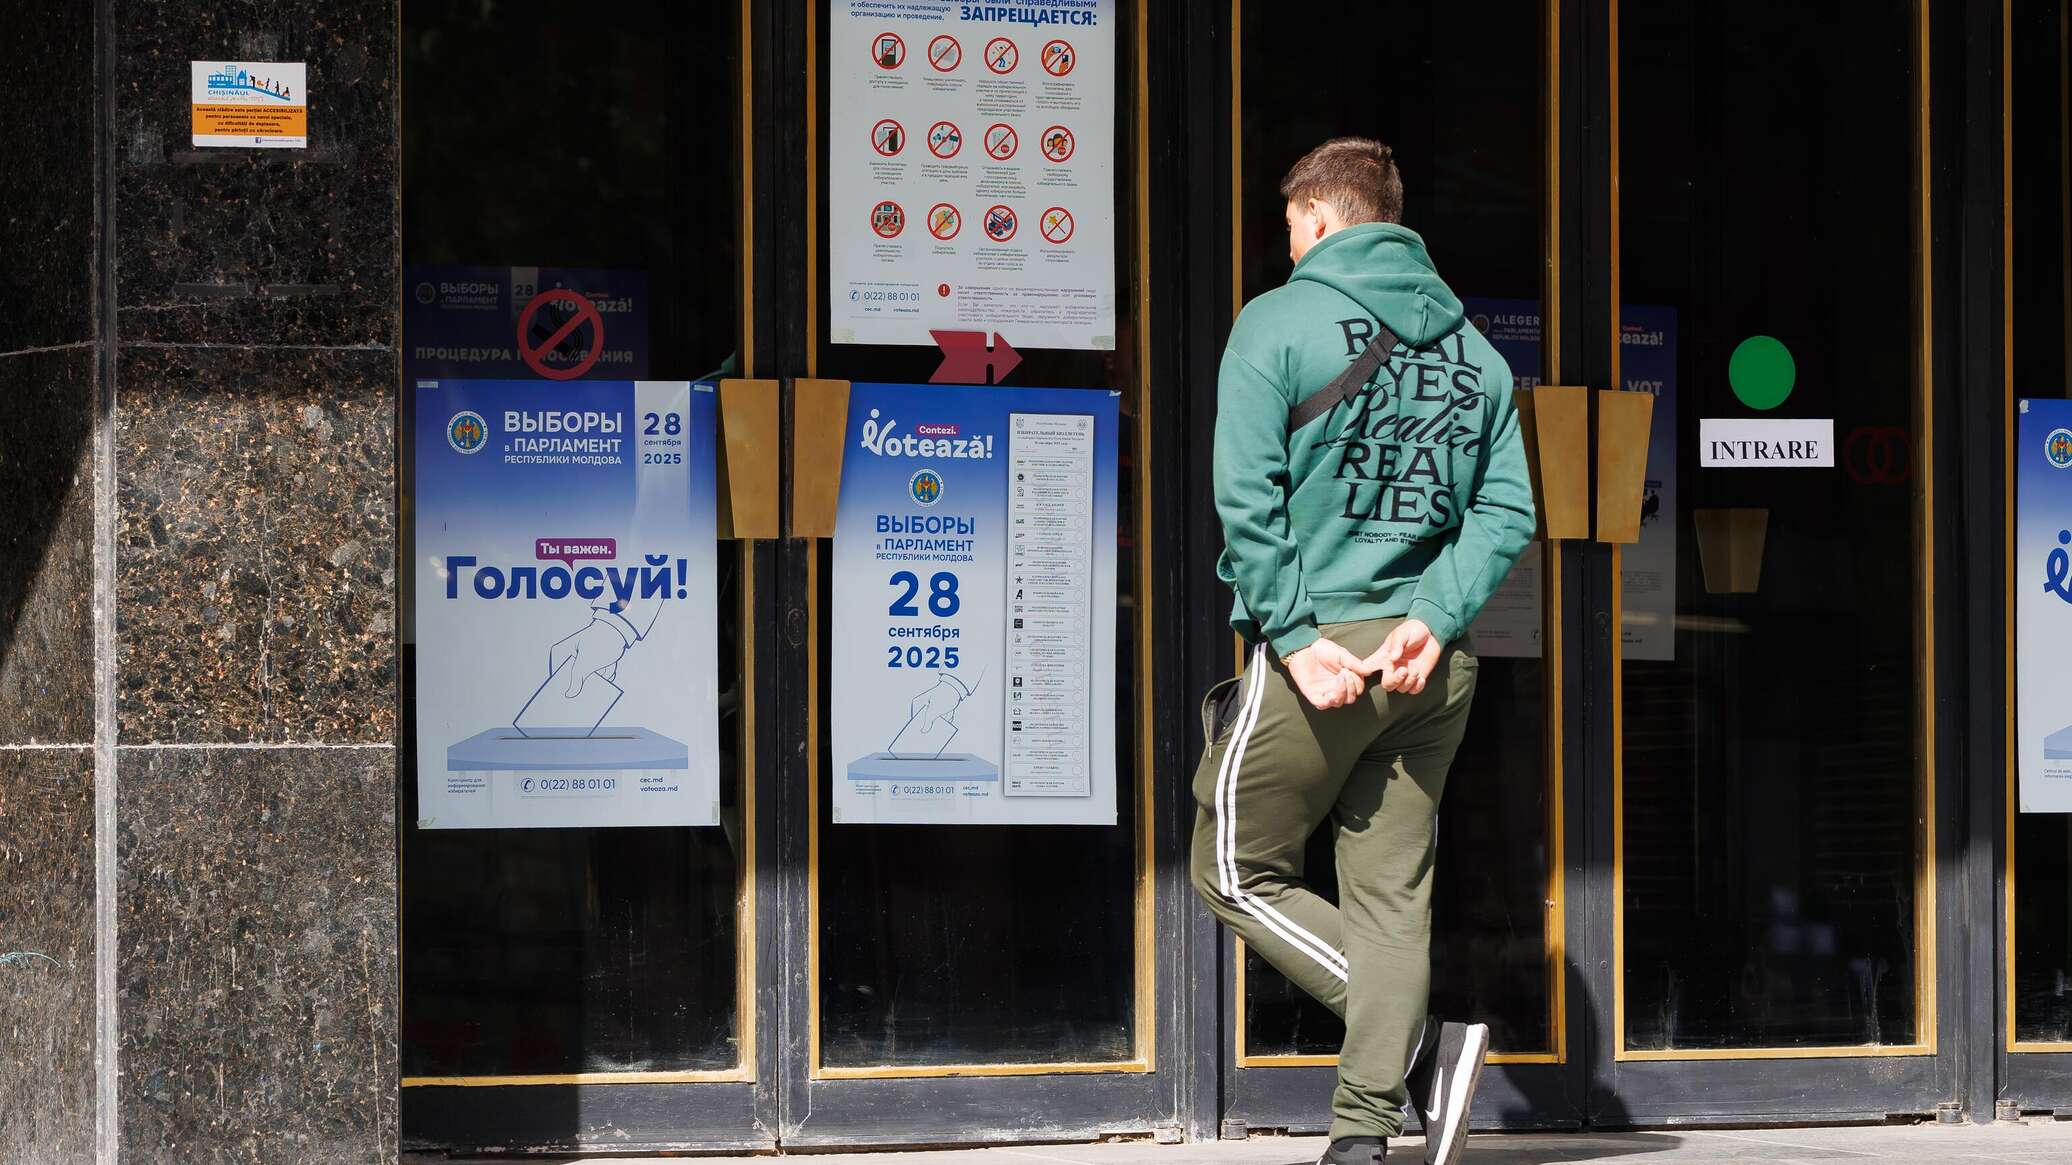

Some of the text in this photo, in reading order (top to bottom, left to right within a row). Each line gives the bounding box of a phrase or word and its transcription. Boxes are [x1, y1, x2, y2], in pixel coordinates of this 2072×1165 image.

[960, 6, 1097, 27] ЗАПРЕЩАЕТСЯ:
[440, 283, 534, 297] ВЫБОРЫ 28
[864, 291, 920, 302] 0(22) 88 01 01
[1493, 314, 1541, 327] ALEGER
[416, 348, 512, 363] ПРОЦЕДУРА
[504, 411, 622, 433] ВЫБОРЫ
[644, 412, 682, 436] 28
[919, 425, 957, 435] Contezi.
[504, 438, 622, 453] в ПАРЛАМЕНТ
[644, 438, 682, 447] сентября
[1711, 440, 1819, 460] INTRARE
[504, 455, 622, 466] РЕСПУБЛИКИ МОЛДОВА
[644, 453, 682, 465] 2025
[1339, 482, 1451, 528] LIES
[876, 514, 975, 535] ВЫБОРЫ
[541, 543, 613, 555] Ты важен.
[885, 538, 974, 552] ПАРЛАМЕНТ
[876, 553, 974, 563] РЕСПУБЛИКИ МОЛДОВА
[446, 554, 688, 614] Голосуй!
[888, 570, 961, 618] 28
[888, 625, 961, 642] сентября
[887, 646, 961, 669] 2025
[541, 779, 616, 792] 0(22) 88 01 01
[925, 786, 935, 794] 88
